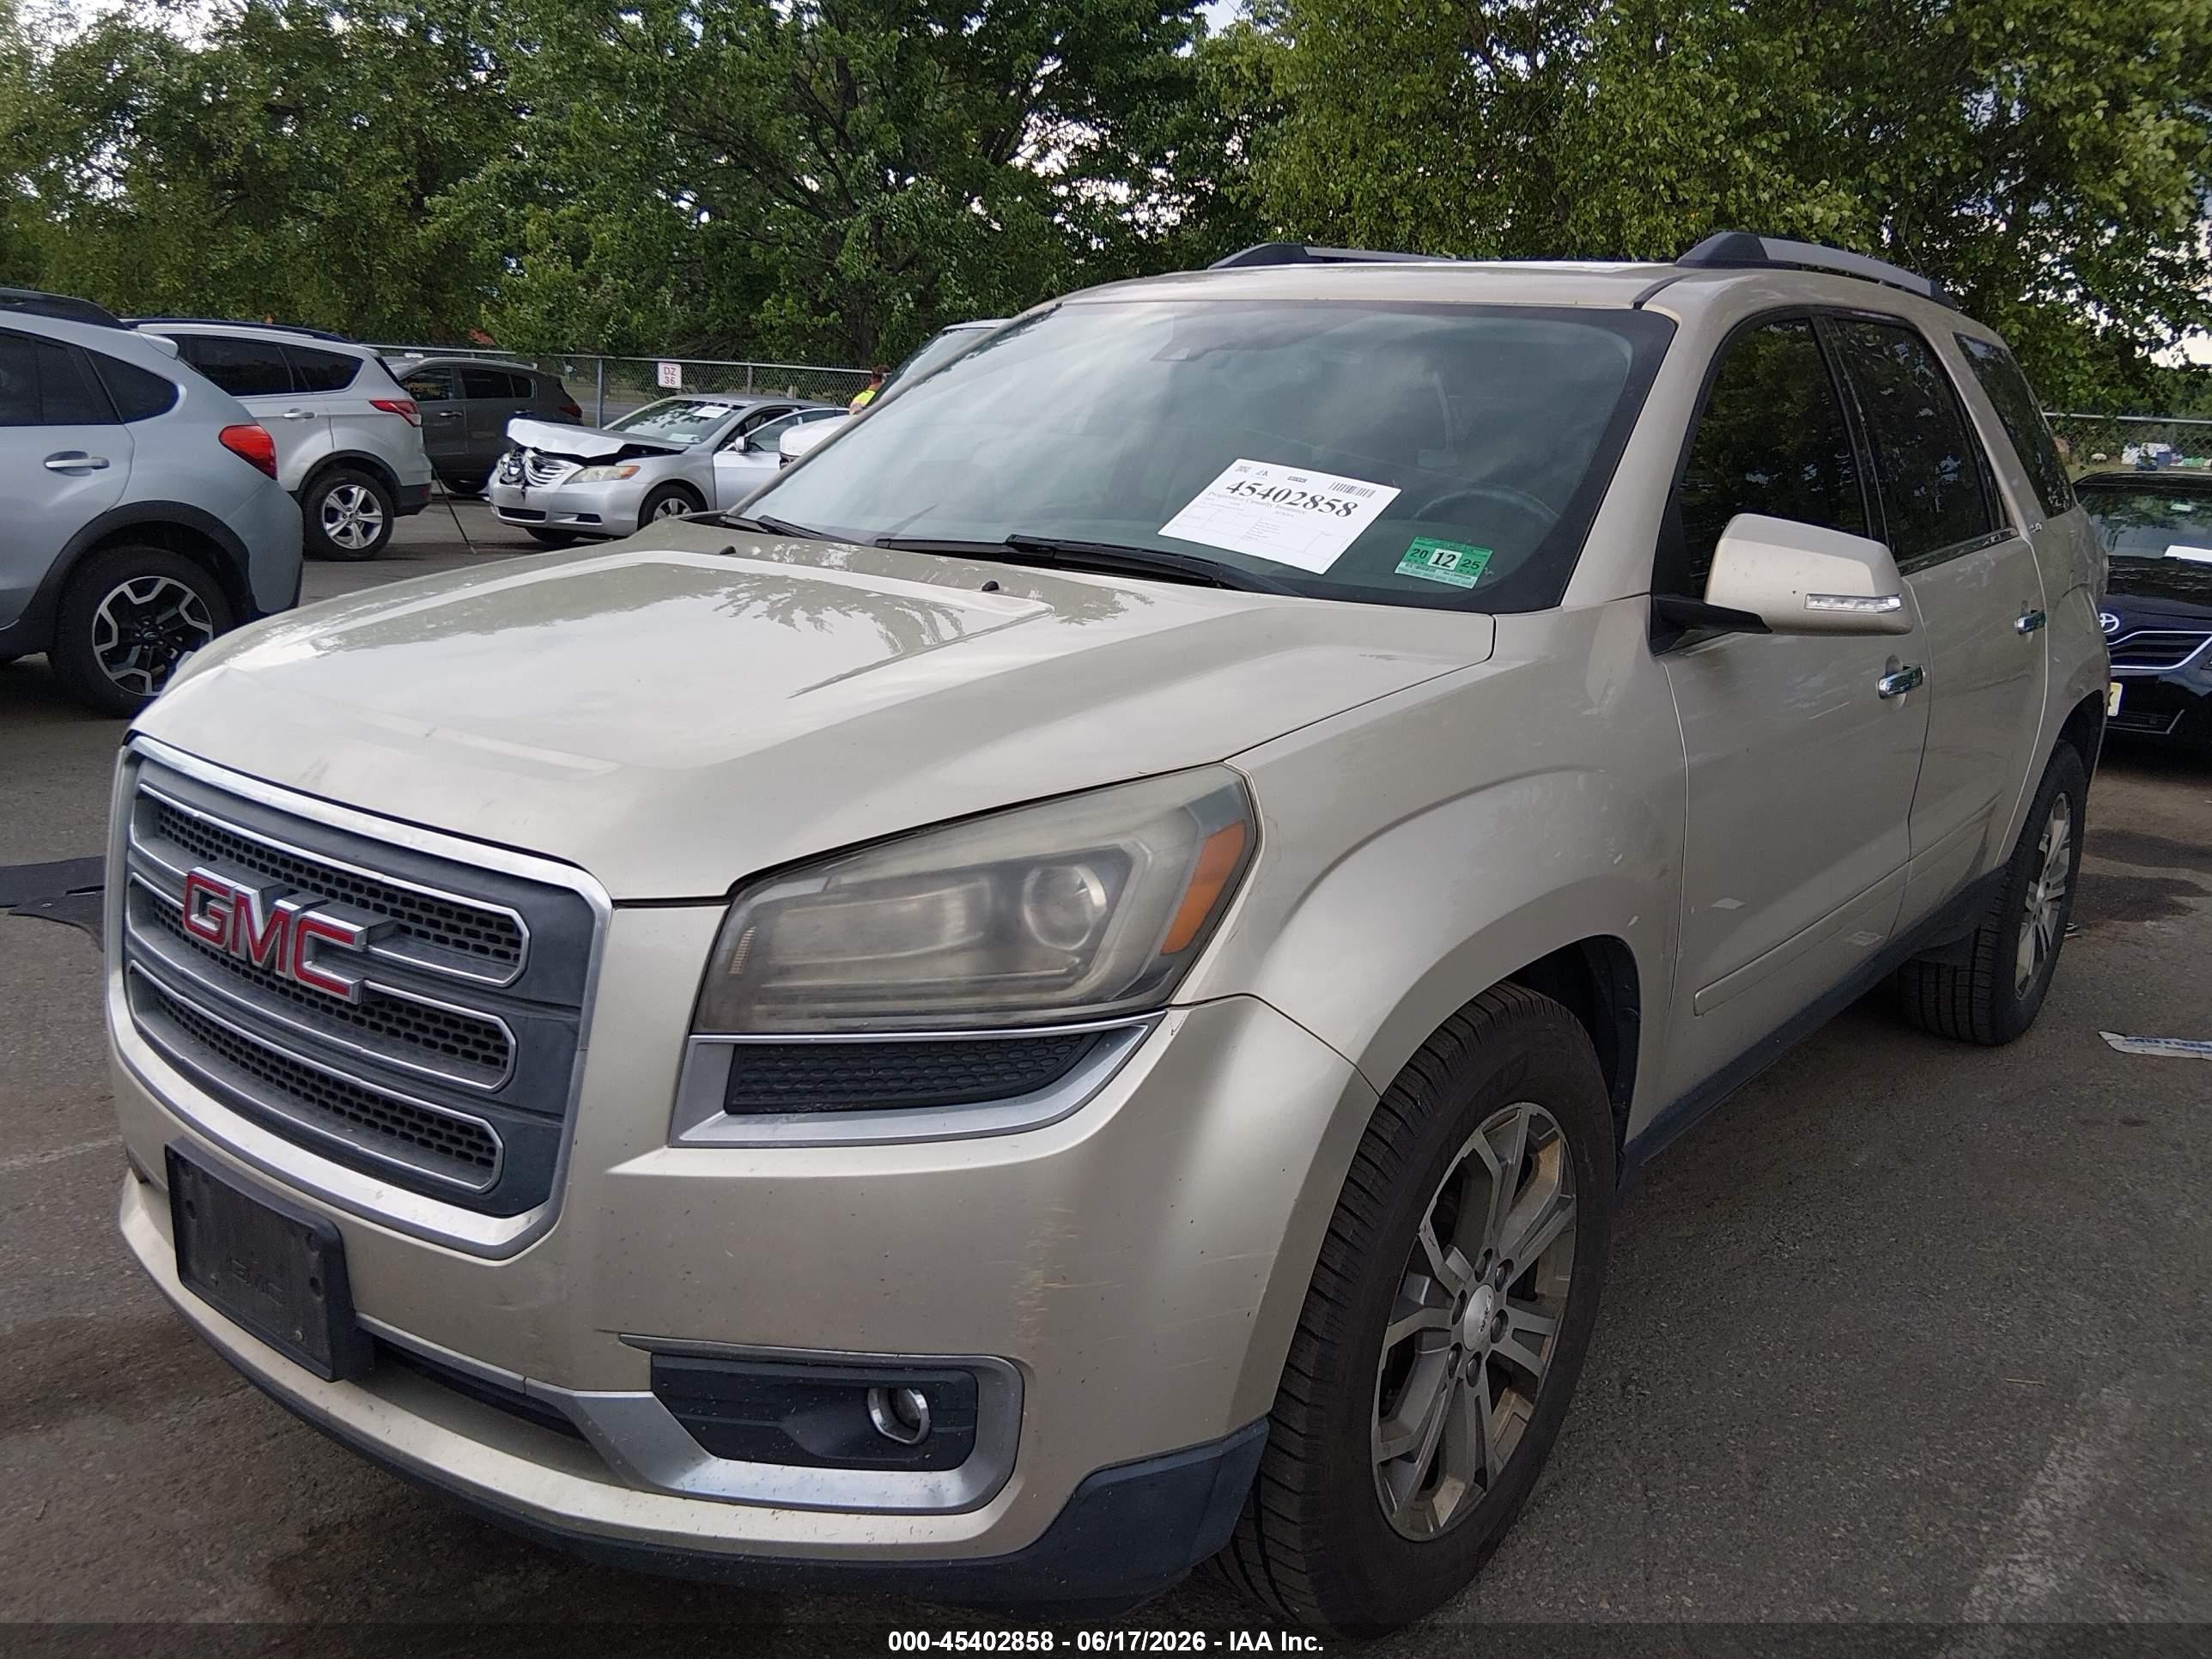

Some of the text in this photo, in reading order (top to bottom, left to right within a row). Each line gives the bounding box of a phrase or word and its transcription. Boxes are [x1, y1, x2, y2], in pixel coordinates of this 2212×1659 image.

[665, 376, 676, 386] 36
[1225, 480, 1358, 517] 45402858
[1411, 548, 1480, 569] 20 12 25
[183, 866, 368, 1005] GMC
